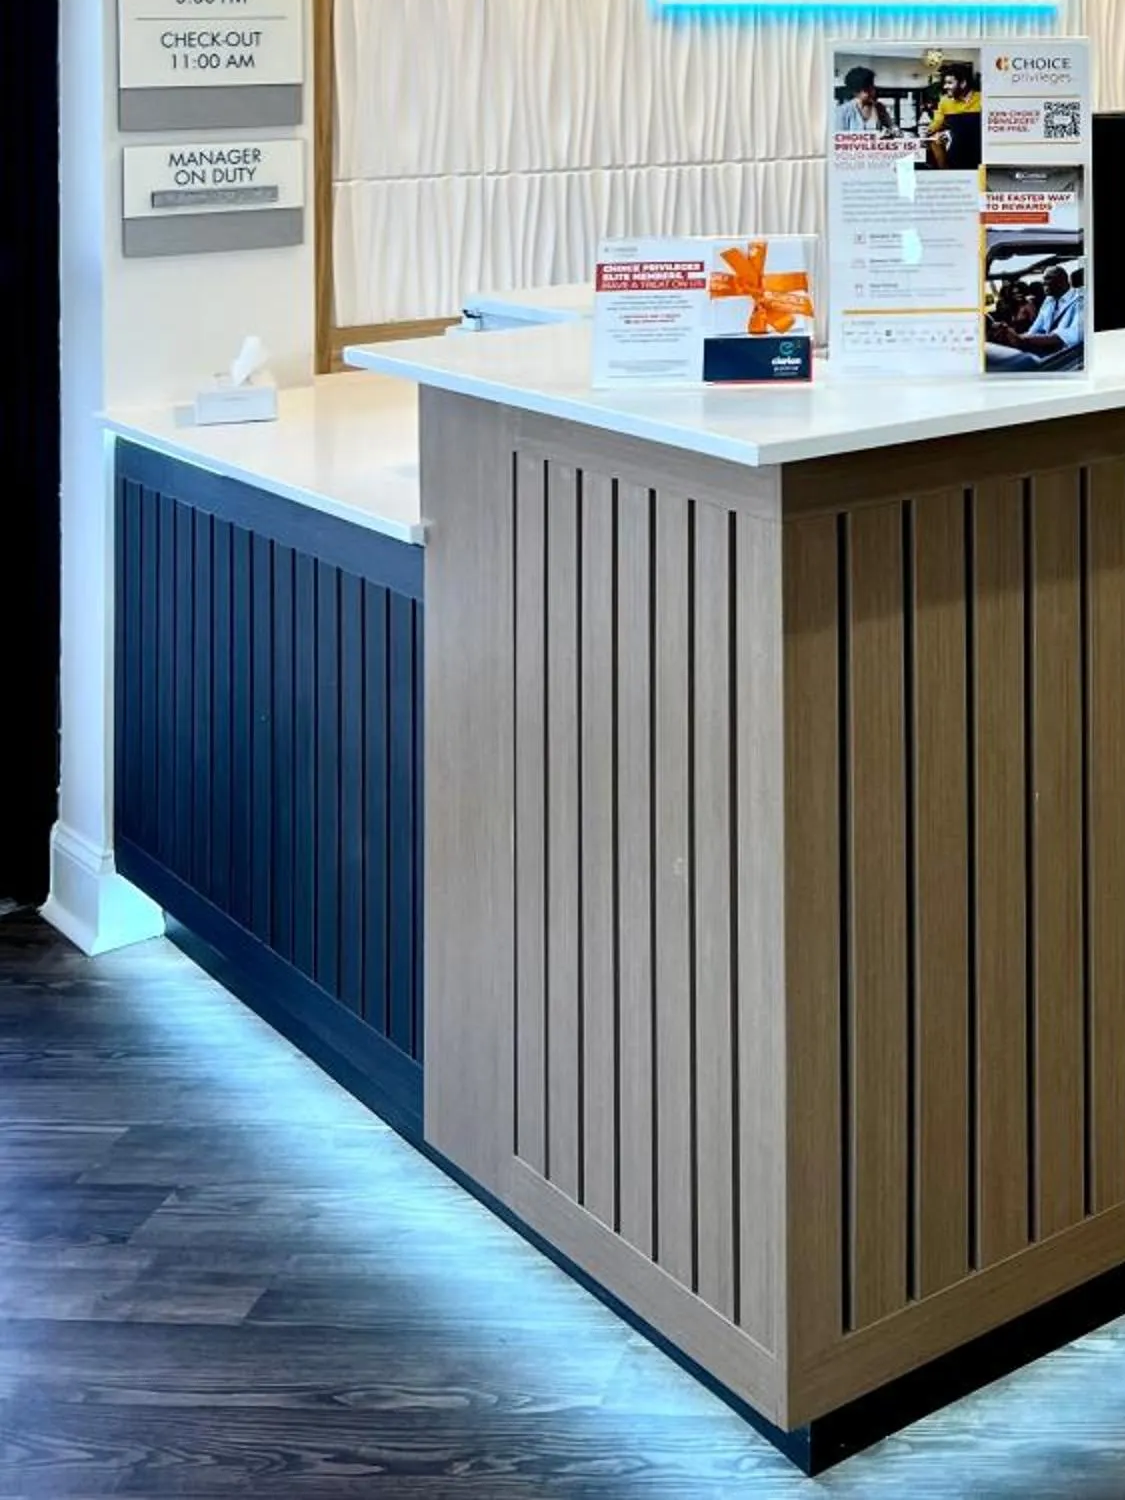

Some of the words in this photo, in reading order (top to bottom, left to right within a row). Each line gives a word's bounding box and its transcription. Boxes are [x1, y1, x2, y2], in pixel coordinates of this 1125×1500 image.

[161, 31, 263, 49] CHECK-OUT
[172, 53, 221, 69] 11:00
[226, 54, 255, 69] AM
[1012, 57, 1071, 70] CHOICE
[835, 133, 876, 142] CHOICE
[168, 148, 262, 167] MANAGER
[174, 169, 206, 185] ON
[212, 167, 257, 184] DUTY
[986, 203, 999, 211] TO
